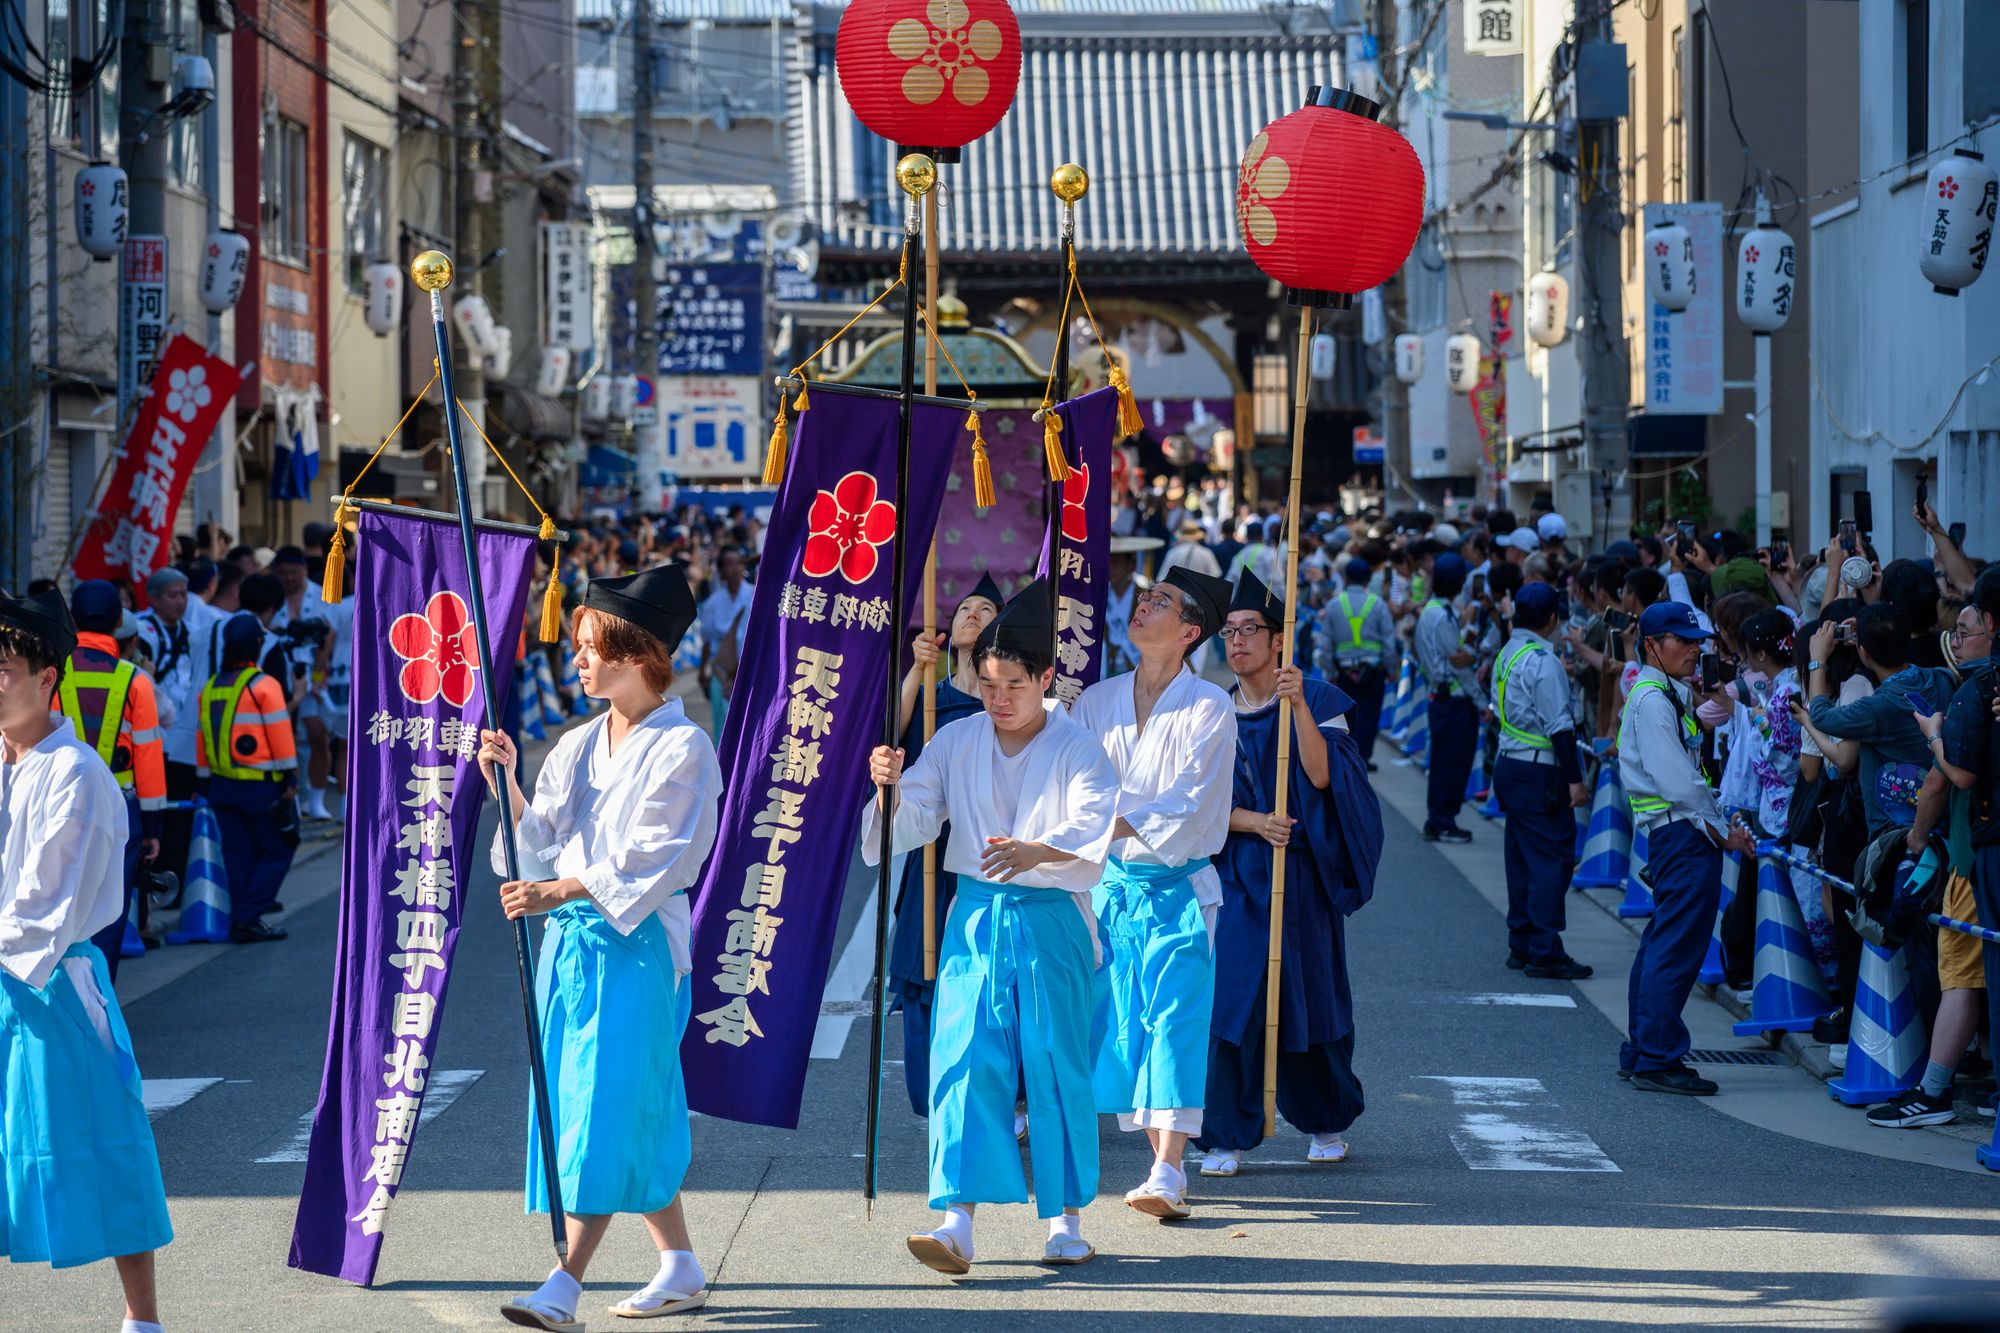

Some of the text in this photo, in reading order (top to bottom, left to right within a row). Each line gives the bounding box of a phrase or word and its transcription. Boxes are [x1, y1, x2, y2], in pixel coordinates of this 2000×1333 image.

[1479, 0, 1511, 40] 館
[366, 709, 478, 763] 御羽車講
[351, 763, 456, 1237] 天神橋四丁目北商店会
